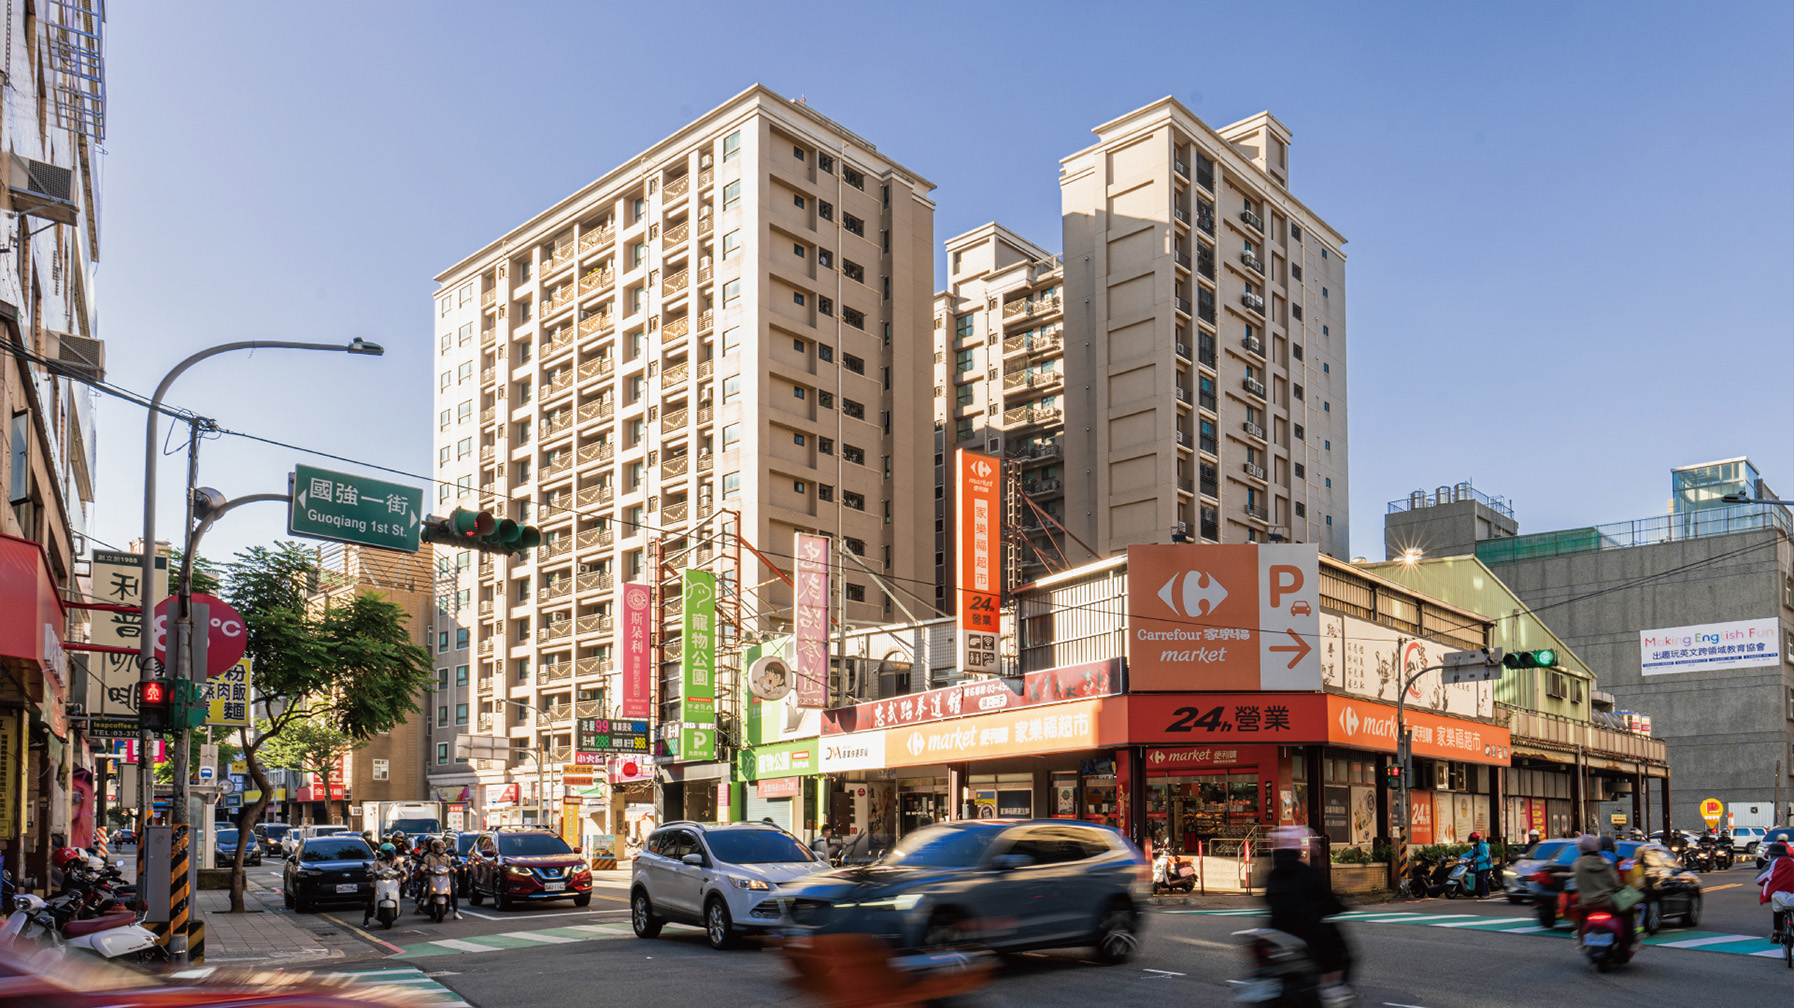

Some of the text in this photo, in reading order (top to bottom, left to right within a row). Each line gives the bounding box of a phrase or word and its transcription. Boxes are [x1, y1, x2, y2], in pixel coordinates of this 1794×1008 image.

[310, 477, 408, 515] 國強一街
[968, 478, 993, 487] market
[308, 508, 407, 537] Guoqiang 1st St.
[976, 506, 987, 586] 家樂福超市
[1269, 564, 1304, 608] P
[631, 612, 643, 654] 斯朵利
[972, 613, 993, 626] 營業
[1137, 628, 1202, 641] Carrefour
[1644, 627, 1775, 647] Making English Fun
[691, 613, 709, 686] 寵物公園
[1160, 647, 1227, 663] market
[874, 689, 961, 727] 忠武跆拳道館
[1165, 705, 1291, 732] 24h營業
[93, 721, 139, 730] leapcoffee.c
[596, 719, 609, 733] 99
[928, 725, 976, 753] market
[1015, 713, 1089, 743] 家樂福超市
[1363, 715, 1408, 742] markt
[1437, 726, 1481, 752] 家樂福超市
[758, 751, 790, 773] 寵物公園
[1168, 749, 1211, 762] market
